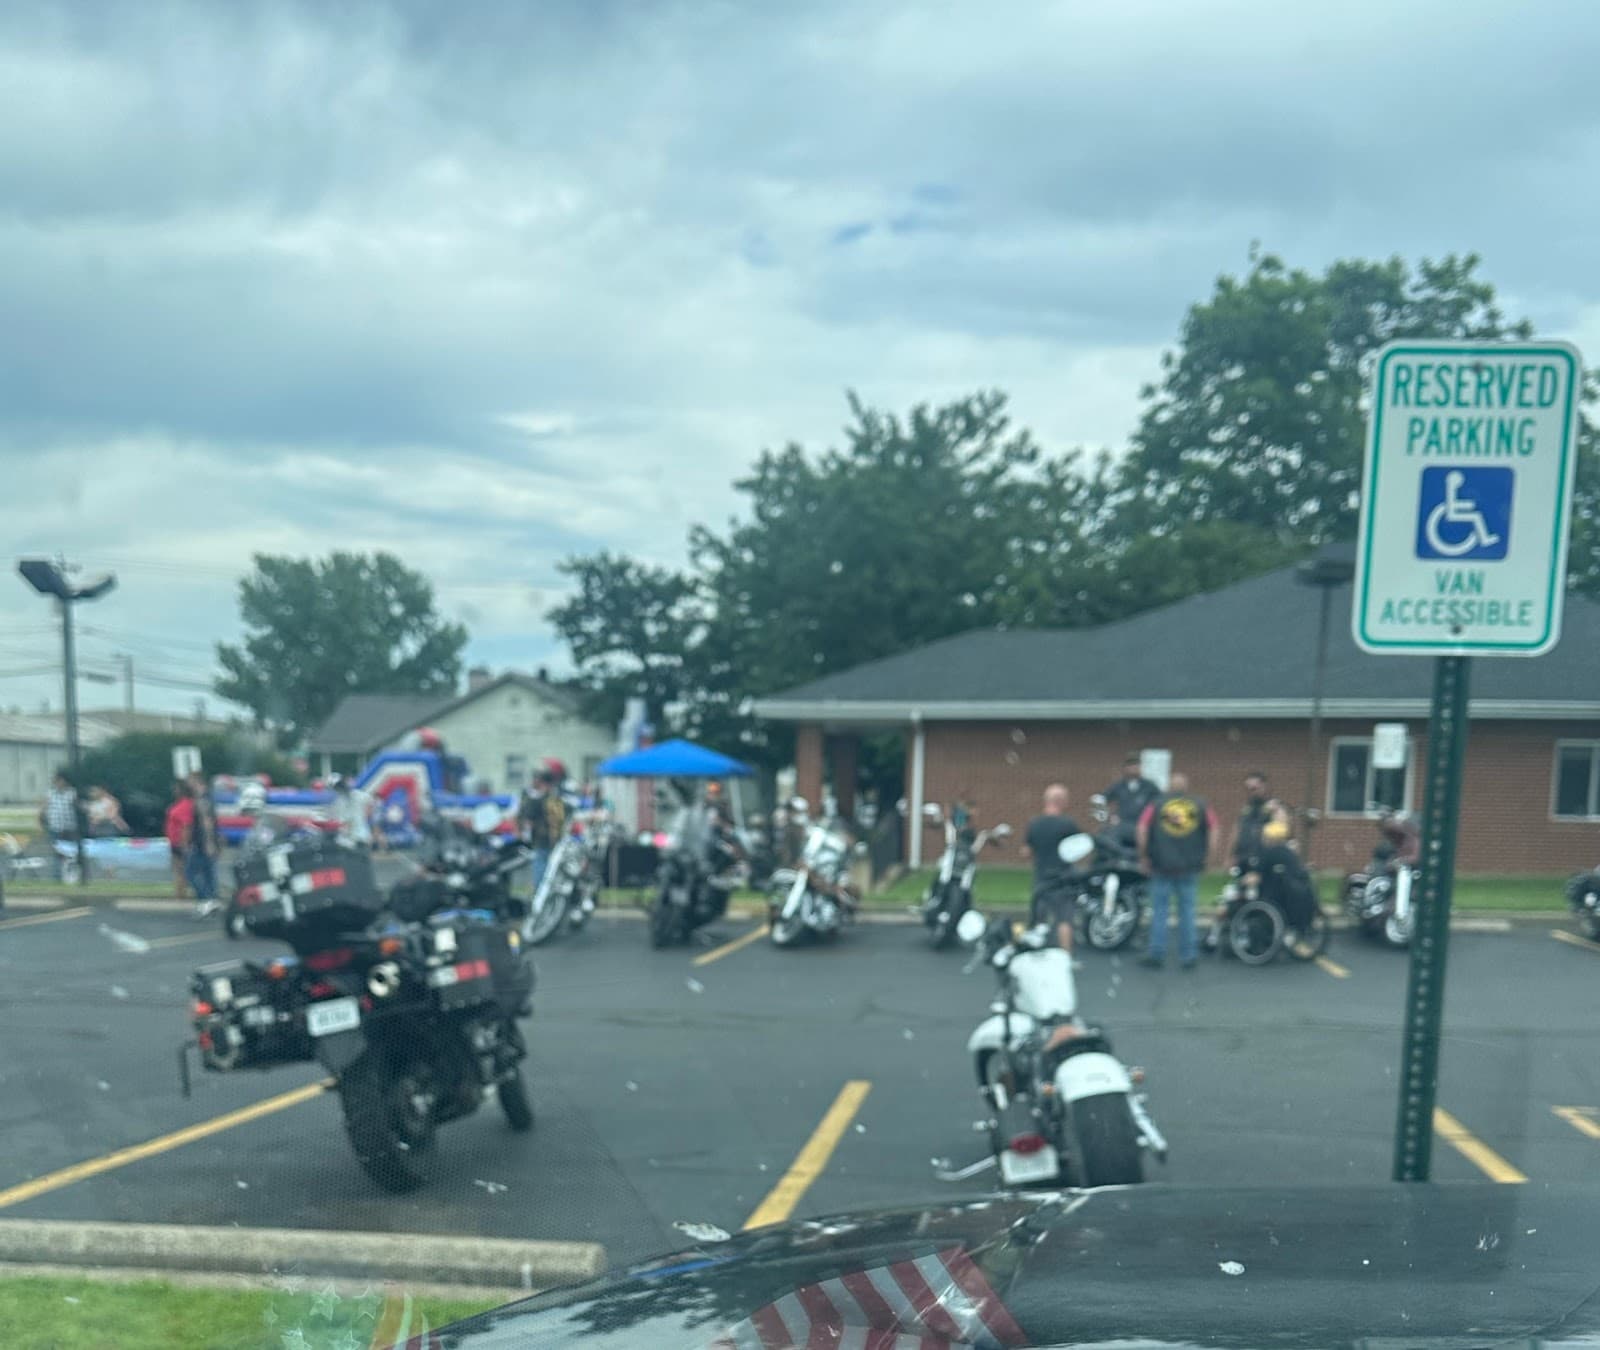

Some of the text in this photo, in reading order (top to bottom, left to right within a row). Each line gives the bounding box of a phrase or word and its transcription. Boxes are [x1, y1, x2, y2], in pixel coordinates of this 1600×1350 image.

[1391, 364, 1558, 408] RESERVED
[1406, 416, 1536, 457] PARKING
[1435, 570, 1485, 595] VAN
[1380, 598, 1532, 627] ACCESSIBLE
